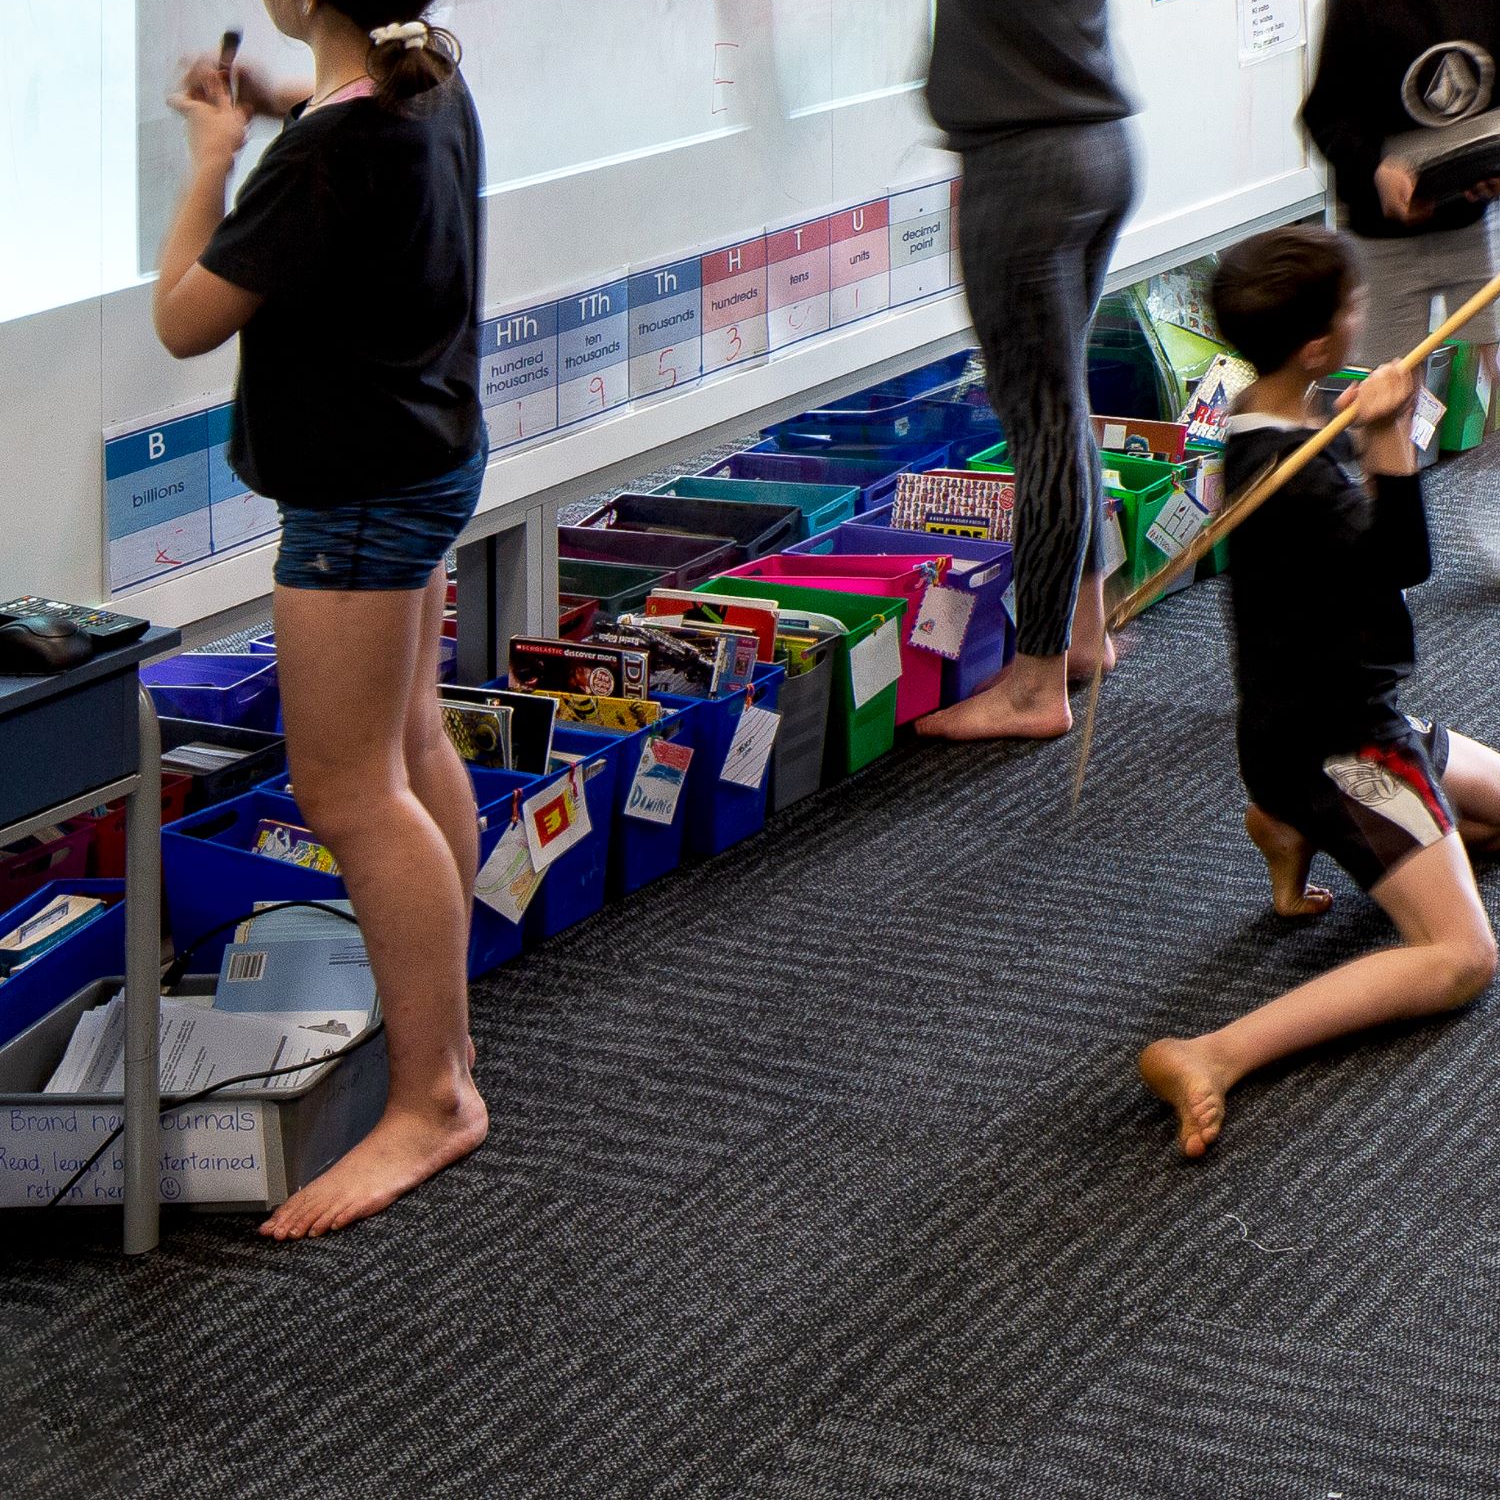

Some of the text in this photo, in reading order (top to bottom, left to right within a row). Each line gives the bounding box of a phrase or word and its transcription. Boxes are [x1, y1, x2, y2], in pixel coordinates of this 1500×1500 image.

[853, 210, 865, 232] U
[902, 221, 942, 242] decimal
[794, 231, 804, 251] T
[910, 237, 935, 256] point
[728, 252, 741, 273] H
[849, 248, 871, 266] units
[654, 271, 678, 296] Th
[789, 269, 810, 286] tens
[578, 291, 611, 321] TTh
[711, 288, 758, 312] hundreds
[496, 315, 538, 348] HTh
[638, 309, 695, 336] thousands
[584, 331, 603, 348] ten
[490, 351, 544, 378] hundred
[565, 340, 621, 370] thousands
[485, 365, 549, 396] thousands
[149, 431, 166, 460] B
[132, 480, 185, 509] billions
[520, 644, 618, 664] SCHOLASTIC discover more
[10, 1109, 79, 1132] Brand
[160, 1106, 256, 1132] ournals
[94, 1179, 125, 1199] her
